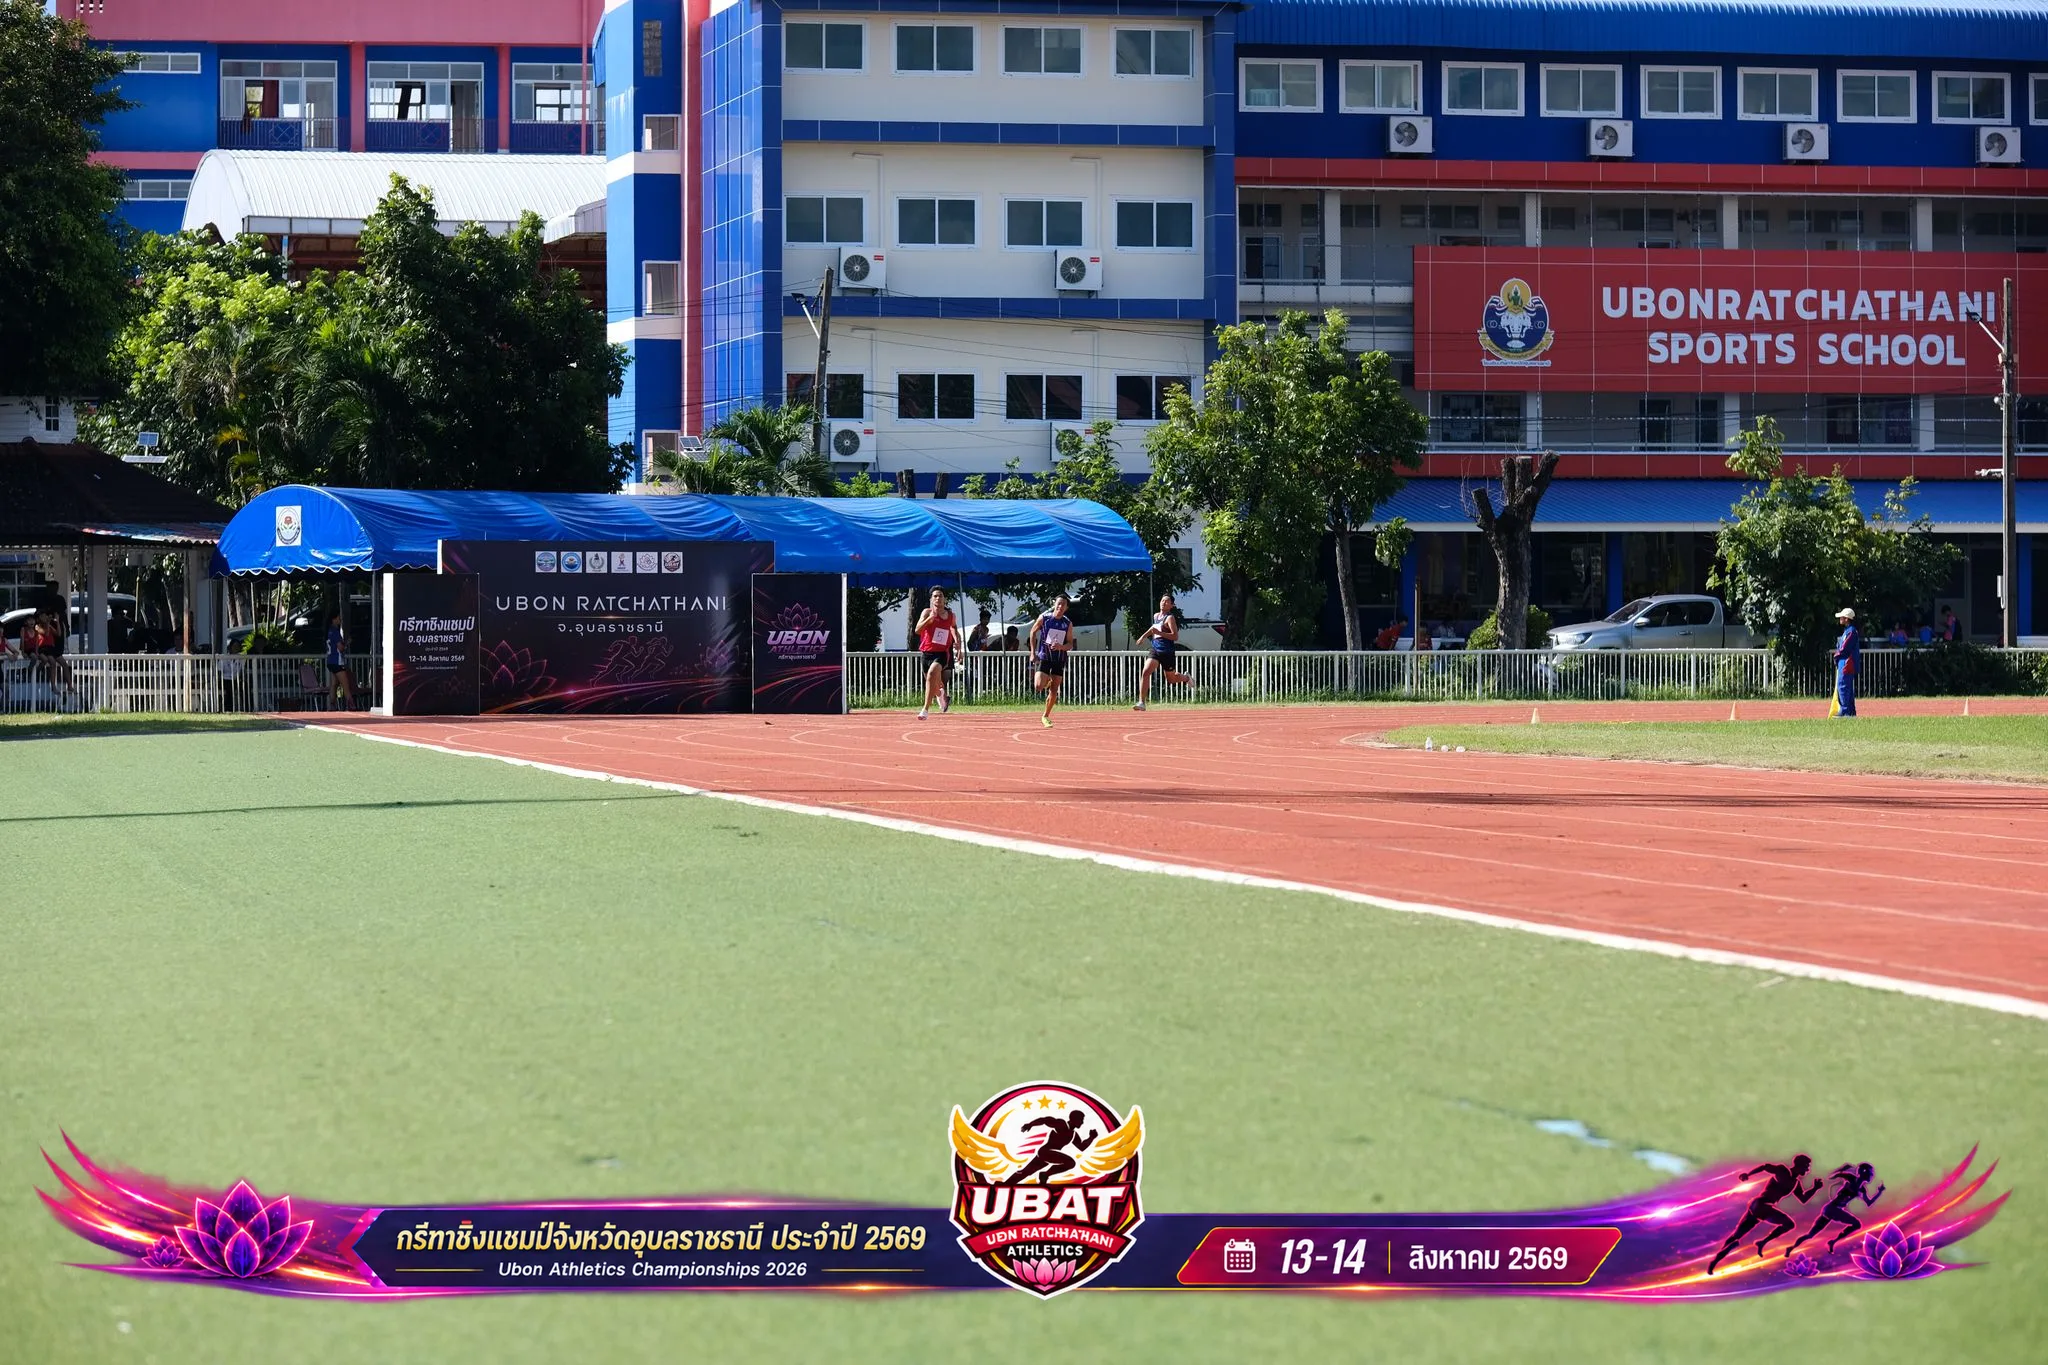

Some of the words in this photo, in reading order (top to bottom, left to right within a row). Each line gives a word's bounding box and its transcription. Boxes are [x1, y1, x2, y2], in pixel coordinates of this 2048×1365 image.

[1602, 286, 1995, 322] UBONRATCHATHANI
[1648, 331, 1796, 364] SPORTS
[1818, 333, 1966, 365] SCHOOL
[496, 596, 565, 611] UBON
[577, 596, 727, 611] RATCHATHANI
[767, 630, 831, 645] UBON
